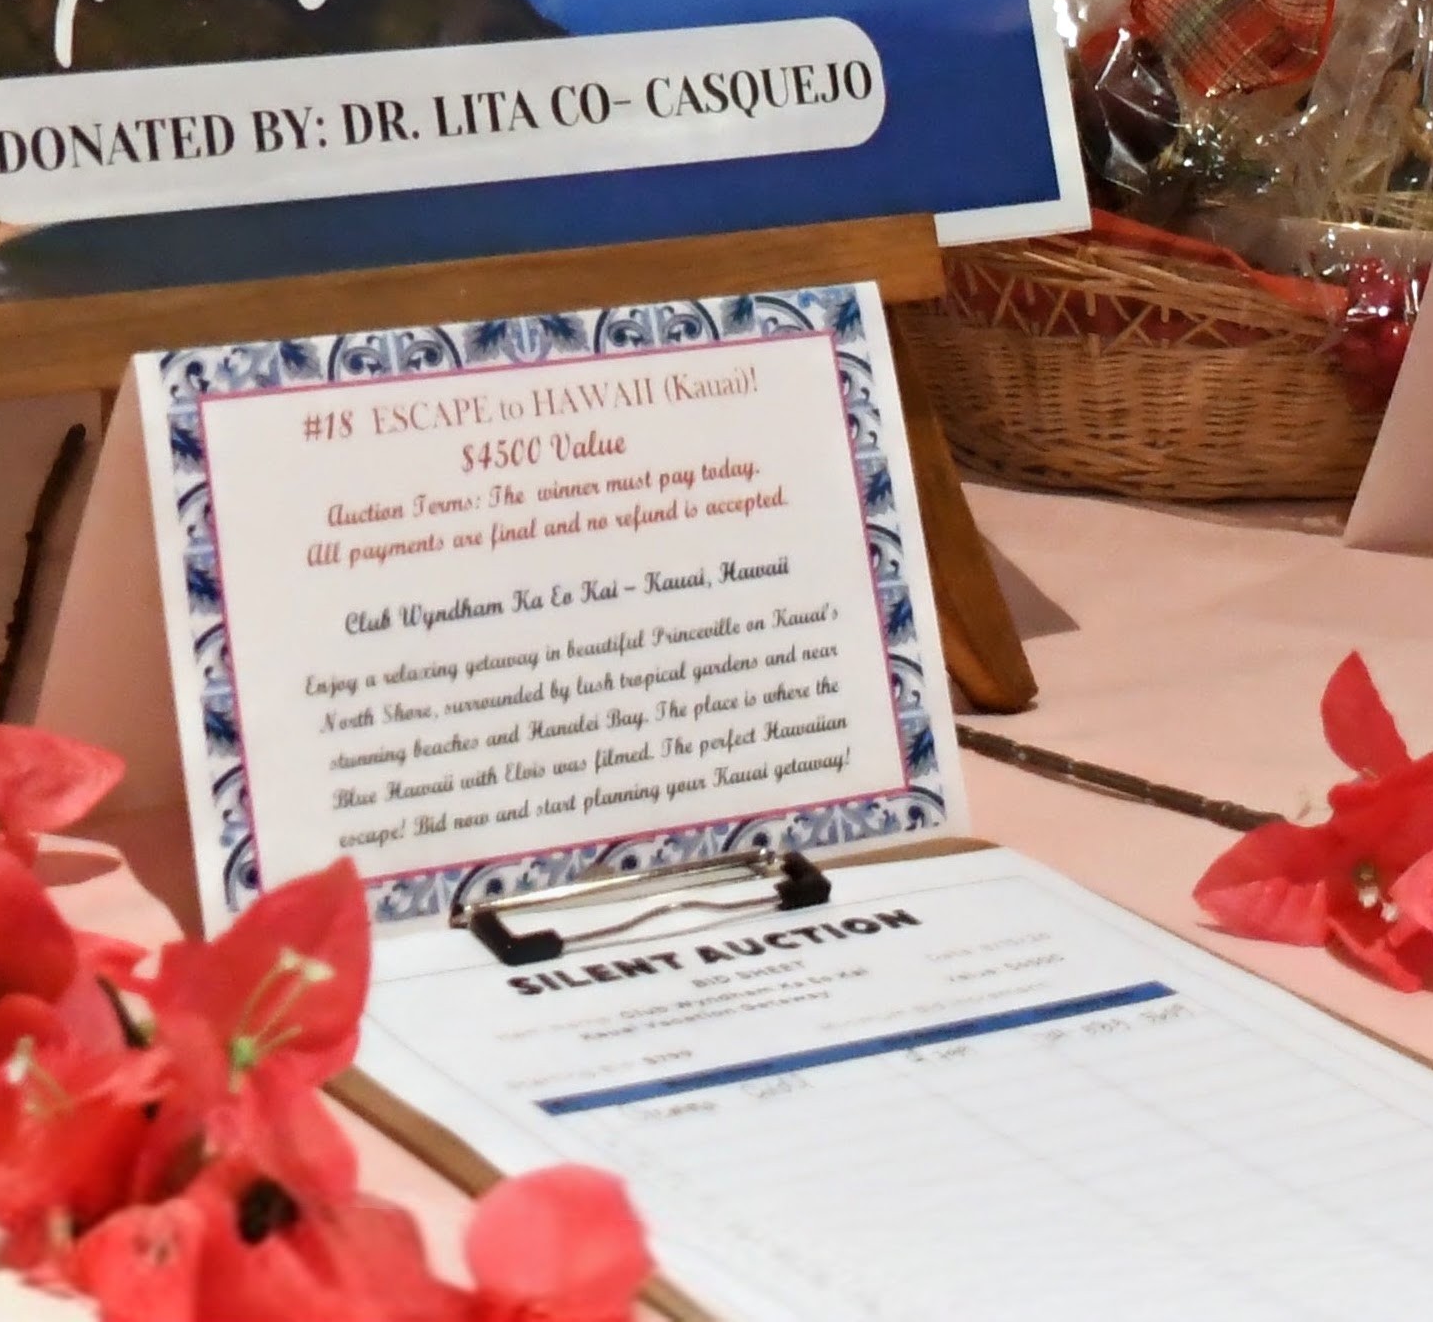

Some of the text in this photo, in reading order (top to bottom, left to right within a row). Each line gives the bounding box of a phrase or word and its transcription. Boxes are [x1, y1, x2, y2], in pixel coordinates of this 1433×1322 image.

[253, 105, 330, 153] BY:
[341, 98, 420, 148] DR.
[434, 88, 537, 138] LITA
[552, 81, 631, 129] CO-
[645, 59, 874, 120] CASQUEJO
[303, 366, 758, 441] #18 ESCAPE to HAWAII (Kauai)!
[327, 456, 760, 527] Auction Terms: The winner must pay today.
[461, 430, 626, 472] $4500 Value
[307, 486, 789, 568] All payments are final and no refund is accepted.
[344, 555, 790, 635] Club Wyndham Ka Eo Kai Kauai, Hawaii
[305, 674, 359, 699] Enjoy
[366, 674, 377, 688] a
[383, 661, 458, 686] relaxing
[465, 651, 539, 678] getaway
[546, 643, 561, 662] in
[567, 629, 645, 658] beautiful
[652, 616, 741, 647] Princeville
[746, 617, 765, 633] on
[320, 643, 838, 734] North Shore, surrounded by lush tropical gardens and near
[329, 674, 839, 771] stunning beaches and Hanalei Bay. The place is where the
[333, 714, 848, 809] Blue Hawaii with Elvis was filmed. The perfect Hawaiian
[507, 952, 684, 995] SILENT
[695, 907, 923, 964] AUCTION
